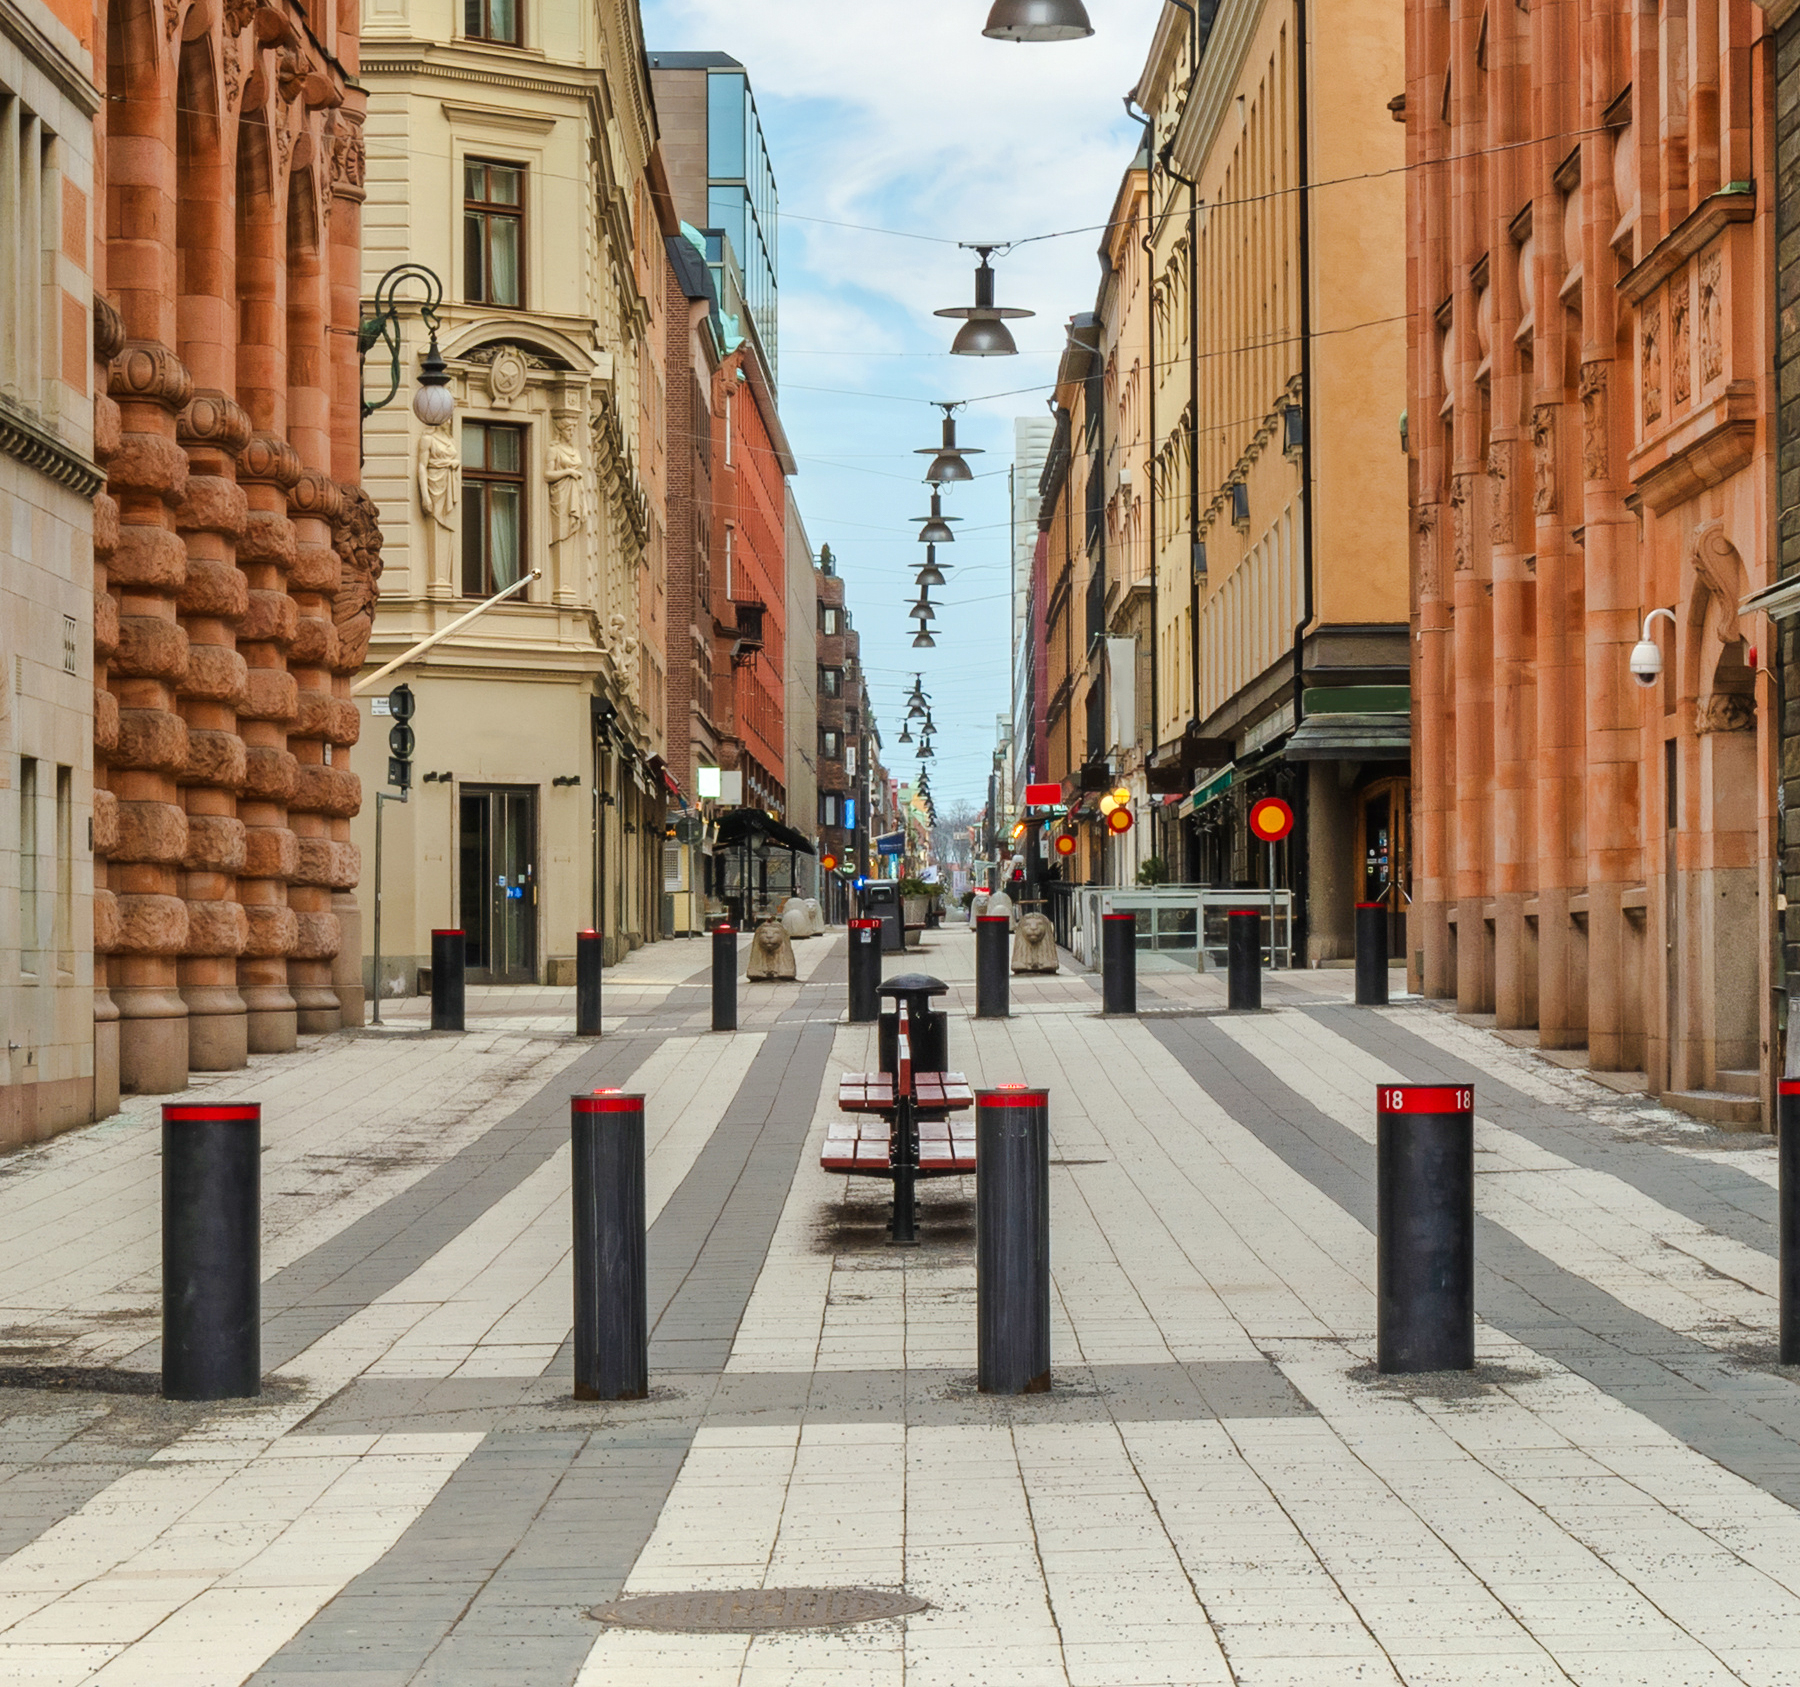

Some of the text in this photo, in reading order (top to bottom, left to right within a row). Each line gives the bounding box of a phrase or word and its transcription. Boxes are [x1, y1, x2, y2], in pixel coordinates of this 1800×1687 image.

[851, 920, 880, 928] 17 17
[1384, 1090, 1471, 1109] 18 18
